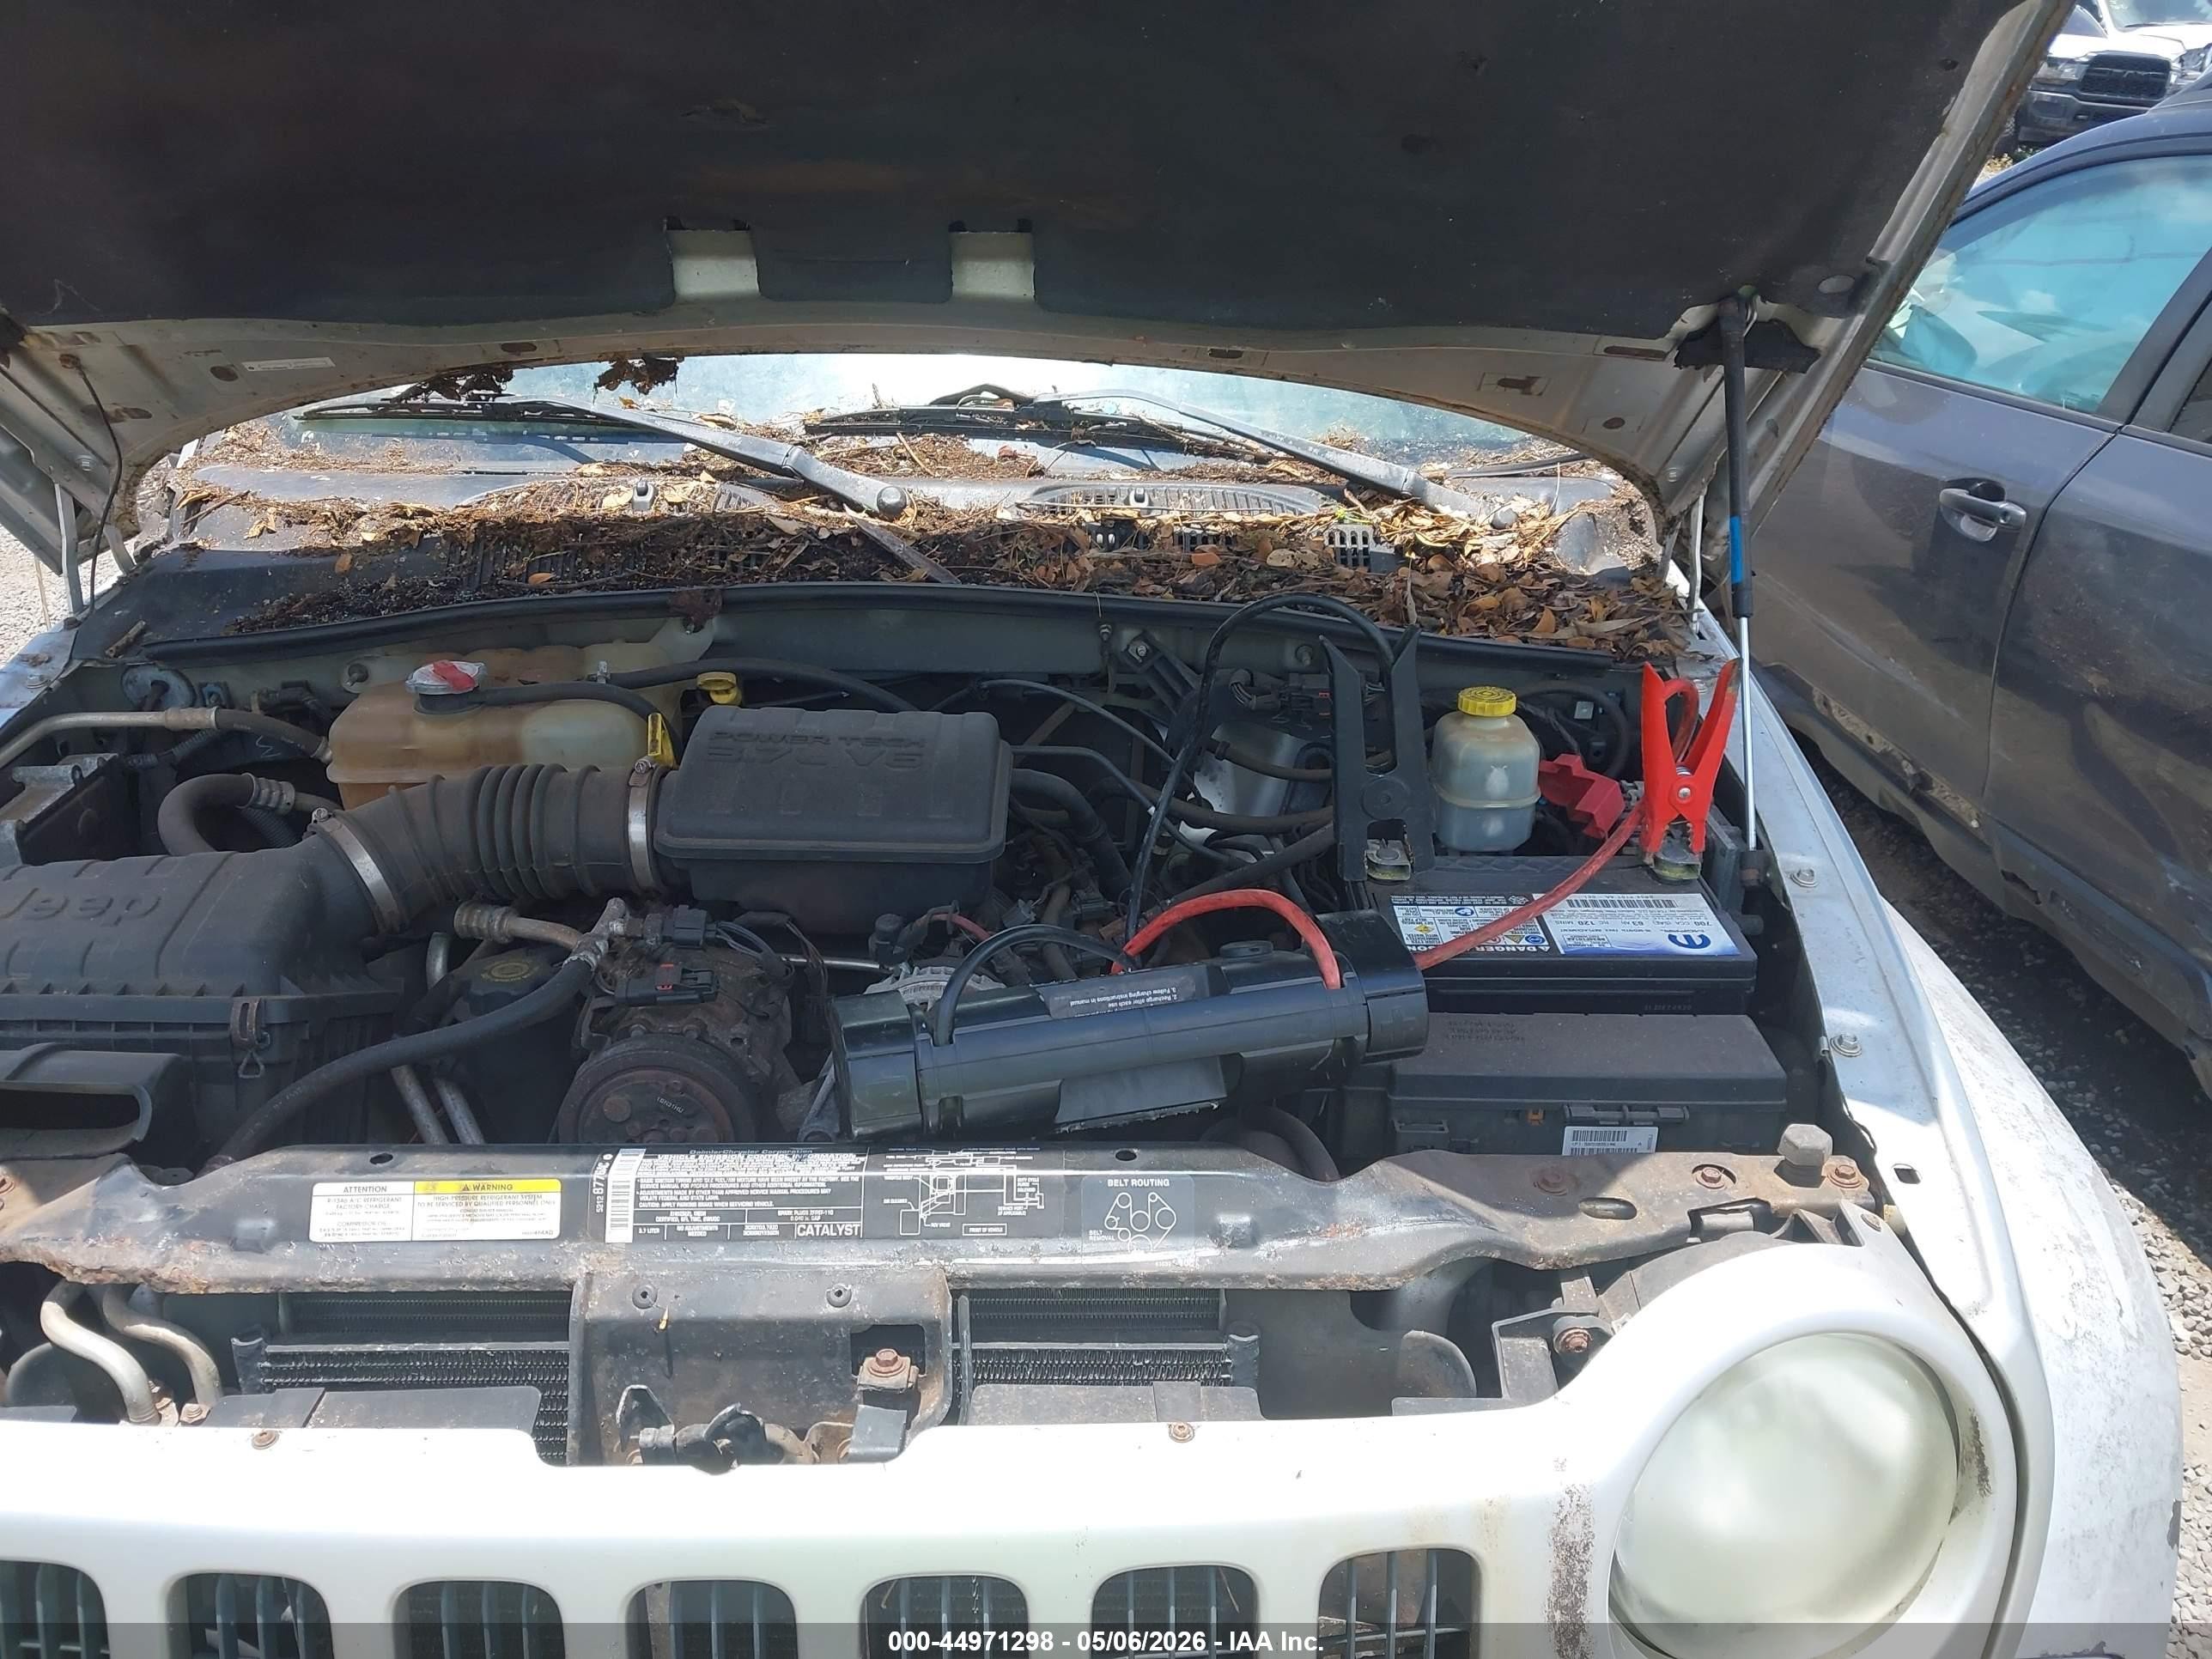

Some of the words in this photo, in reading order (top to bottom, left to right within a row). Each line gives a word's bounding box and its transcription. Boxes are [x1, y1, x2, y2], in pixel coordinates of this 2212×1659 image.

[1108, 1179, 1128, 1188] BELT
[1131, 1179, 1170, 1188] ROUTING
[798, 1224, 861, 1237] CATALYST
